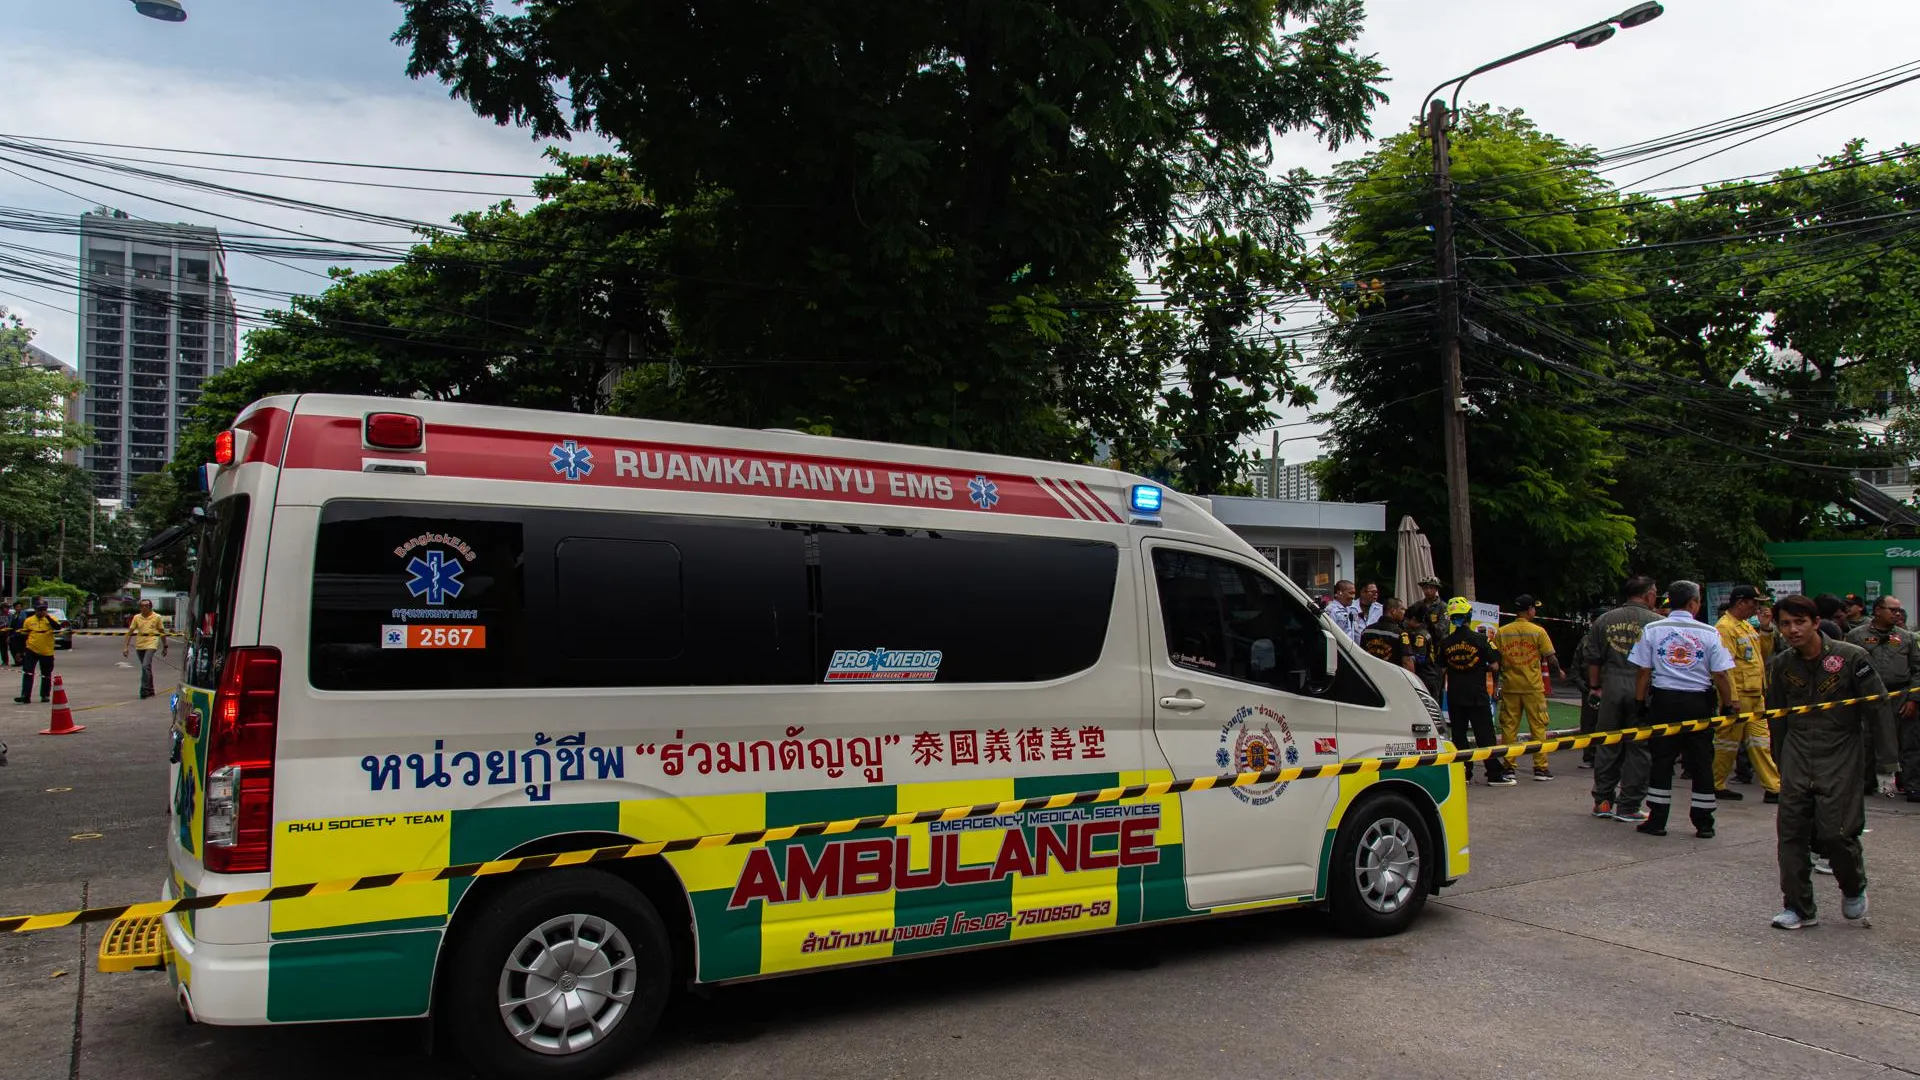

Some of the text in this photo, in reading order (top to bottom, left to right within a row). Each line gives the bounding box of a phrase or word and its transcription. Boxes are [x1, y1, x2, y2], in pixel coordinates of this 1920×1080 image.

[614, 449, 954, 500] RUAMKATANYU EMS
[393, 531, 477, 562] BangkokEMS
[420, 628, 473, 646] 2567
[831, 652, 941, 667] PRO MEDIC
[635, 725, 900, 783] “ร่วมกตัญญู”
[910, 725, 1107, 767] 泰國義德善堂
[360, 731, 625, 802] หน่วยกู้ชีพ
[328, 817, 396, 830] SOCIETY
[403, 814, 445, 825] TEAM
[930, 804, 1160, 832] EMERGENCY MEDICAL SERVICES
[726, 817, 1160, 910] AMBULANCE
[801, 916, 946, 953] สำนักงานบางพลี
